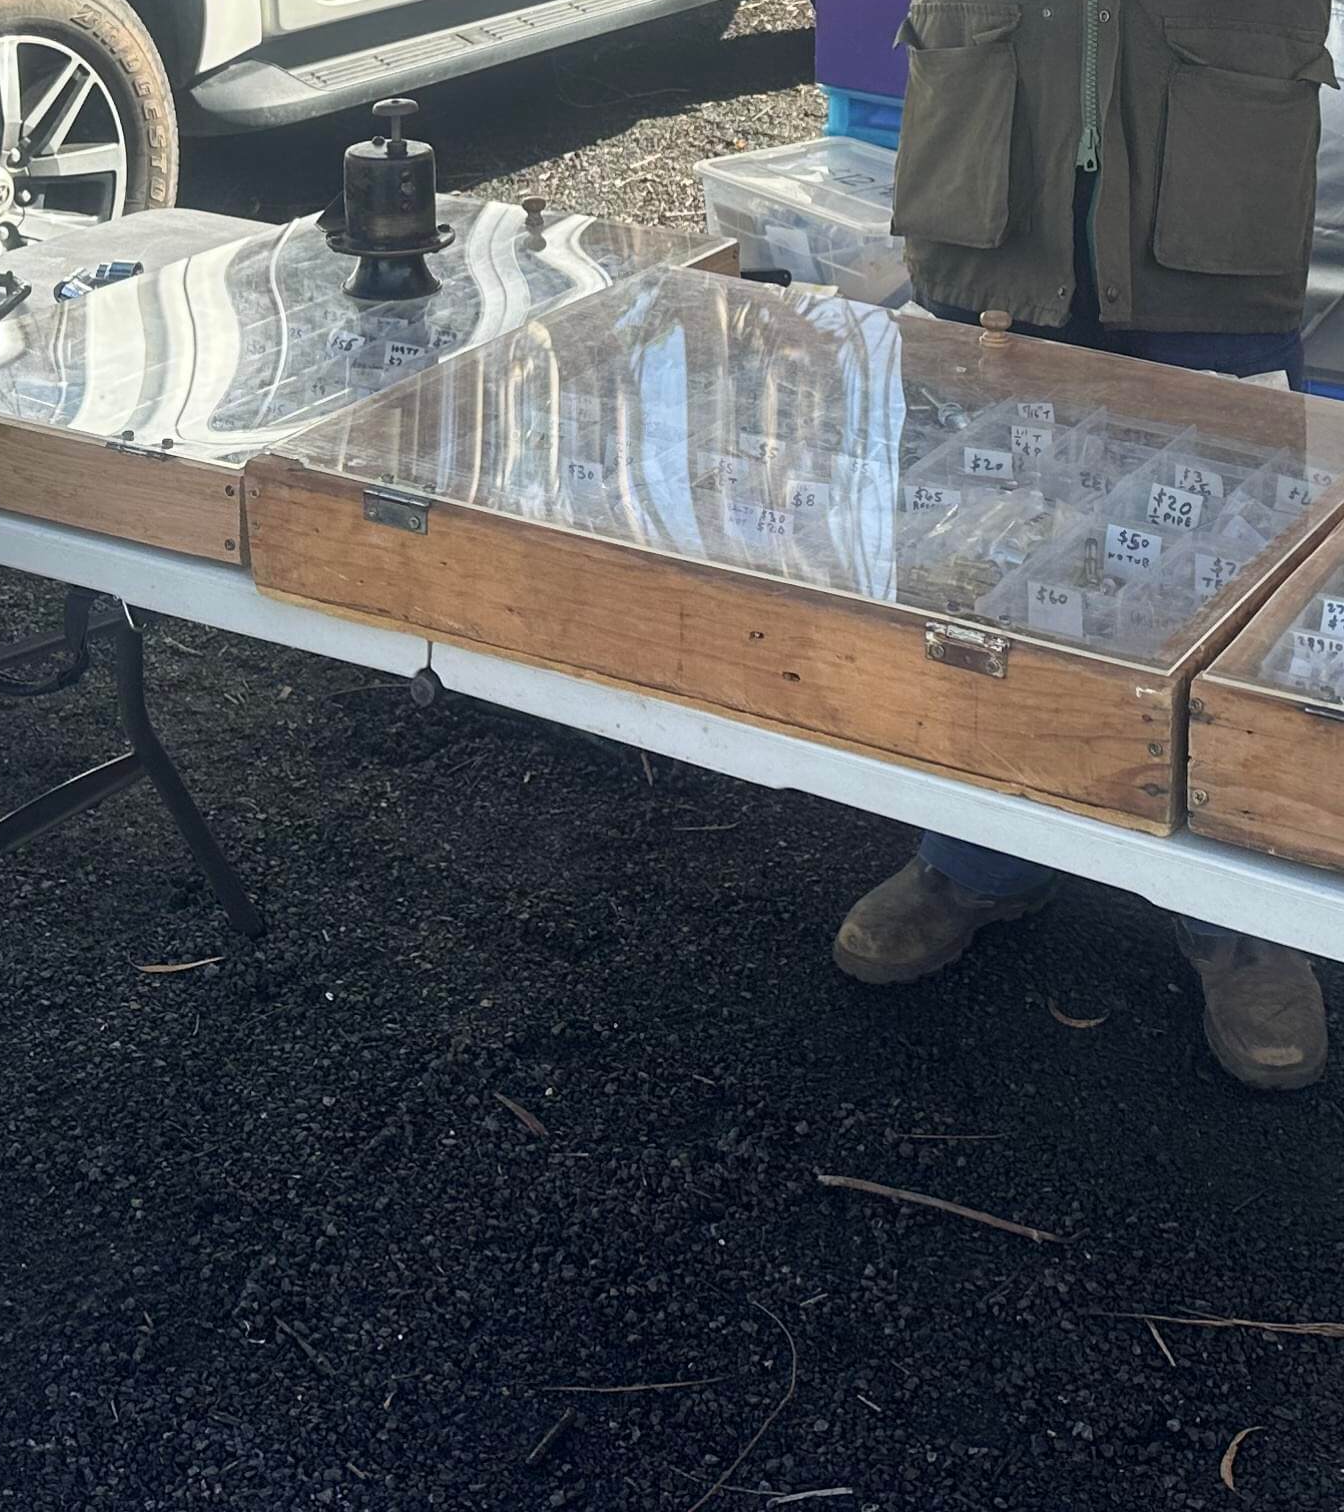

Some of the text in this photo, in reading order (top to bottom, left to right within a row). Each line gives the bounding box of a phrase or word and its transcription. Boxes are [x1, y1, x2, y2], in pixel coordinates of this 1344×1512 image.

[970, 455, 1003, 472] $20
[1153, 488, 1192, 516] $20
[1163, 512, 1192, 528] PIPE
[1117, 530, 1149, 550] $50
[1036, 587, 1068, 604] $60
